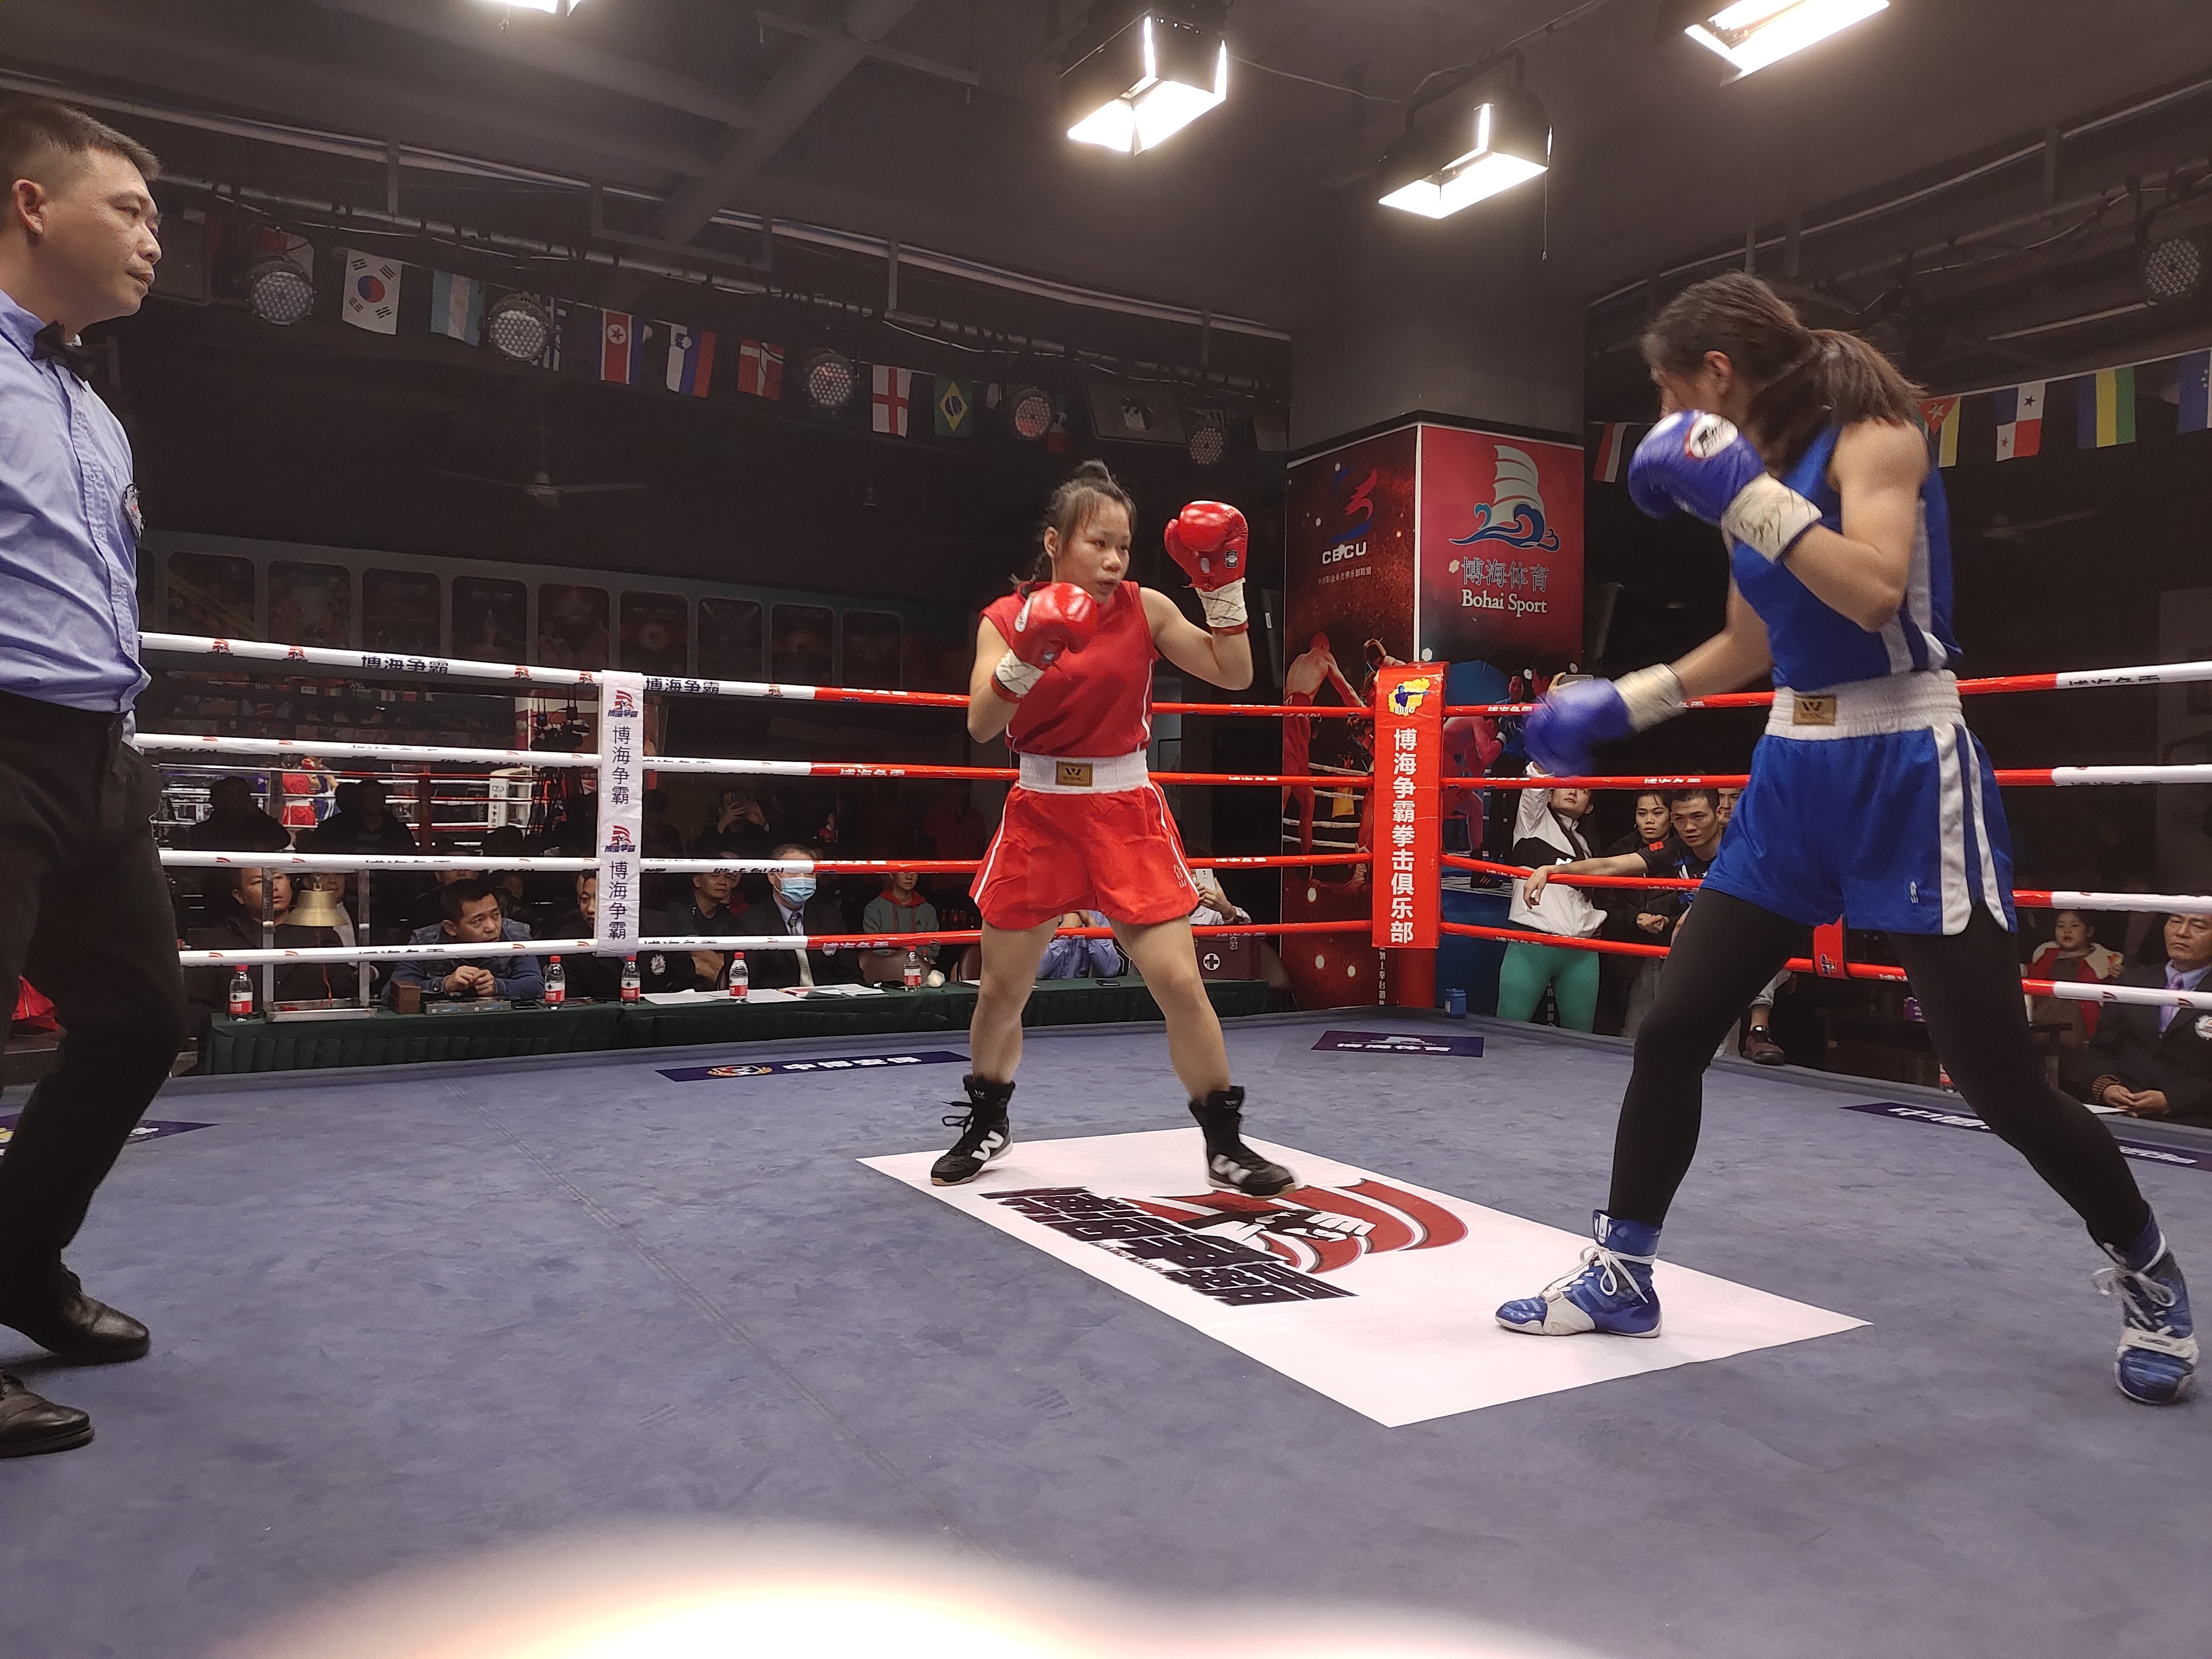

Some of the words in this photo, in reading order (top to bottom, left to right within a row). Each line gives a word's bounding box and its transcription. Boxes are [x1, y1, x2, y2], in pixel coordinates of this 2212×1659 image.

[1461, 556, 1549, 593] 博海体育
[1461, 589, 1505, 611] Bohai
[1507, 593, 1547, 617] Sport
[362, 655, 448, 674] 博海争霸
[646, 677, 719, 694] 博海争霸
[611, 725, 631, 805] 博海争霸
[1390, 728, 1417, 944] 博海争霸拳击俱乐部
[608, 860, 628, 940] 博海争霸
[978, 1186, 1360, 1306] 博海争霸
